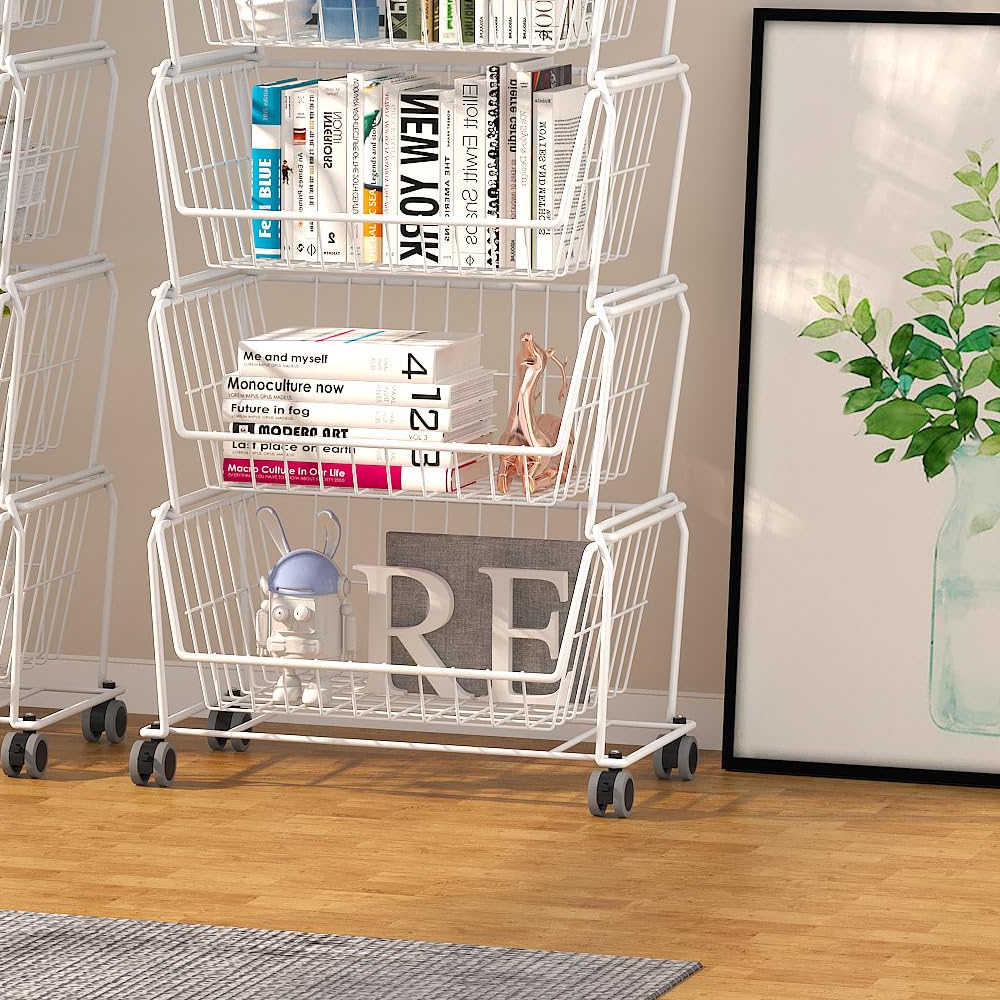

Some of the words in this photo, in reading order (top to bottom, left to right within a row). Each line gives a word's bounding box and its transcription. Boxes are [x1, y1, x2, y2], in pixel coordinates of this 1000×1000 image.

[259, 158, 271, 198] BLUE
[370, 157, 378, 185] Legends
[369, 189, 377, 207] SEA
[259, 205, 271, 238] Fel
[243, 352, 262, 361] Me
[265, 353, 287, 362] and
[291, 354, 328, 364] myself
[402, 353, 428, 379] 4
[227, 377, 311, 393] Monoculture
[316, 384, 344, 394] now
[412, 388, 442, 400] 1
[231, 404, 269, 414] Future
[274, 405, 284, 414] in
[288, 406, 310, 418] fog
[410, 408, 438, 430] 2
[323, 428, 348, 438] ART
[260, 443, 298, 452] place
[227, 464, 259, 474] Macro
[298, 467, 306, 475] In
[330, 469, 345, 478] Life
[352, 564, 573, 705] RE
